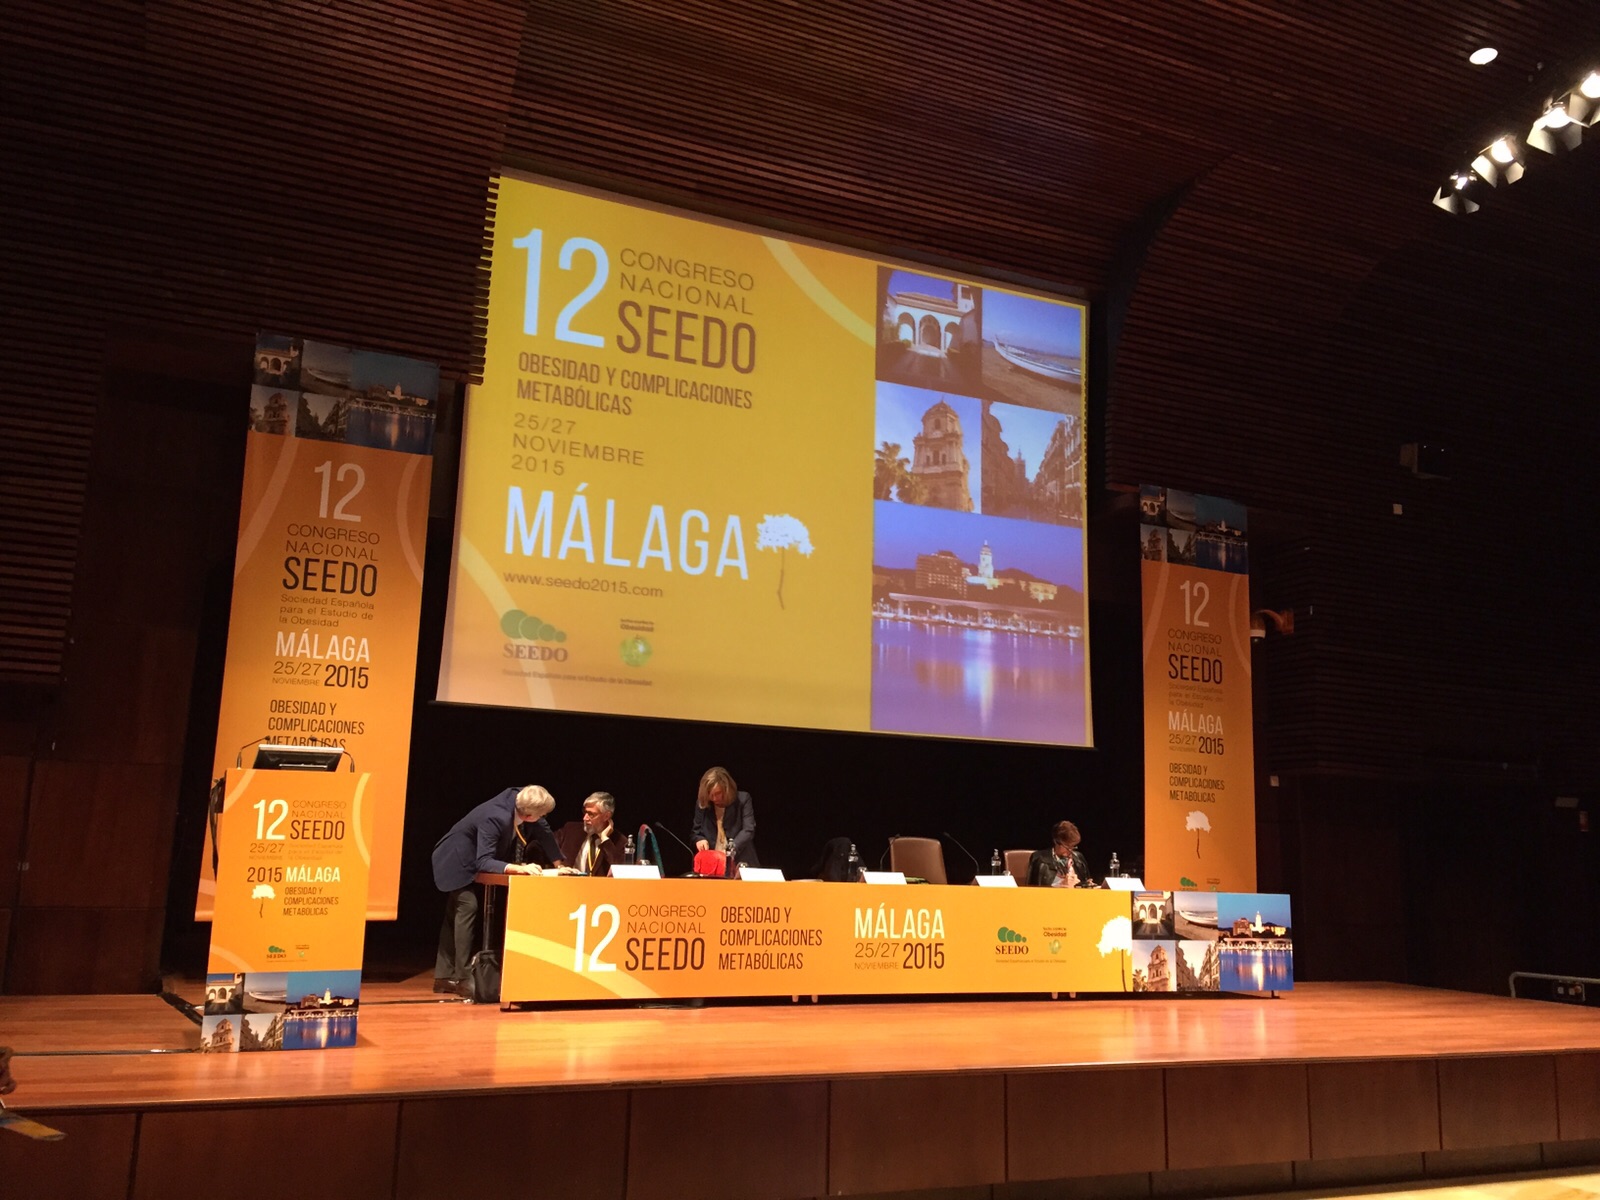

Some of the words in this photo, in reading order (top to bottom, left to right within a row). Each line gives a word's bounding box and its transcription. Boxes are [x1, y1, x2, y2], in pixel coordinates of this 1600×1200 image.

[619, 248, 754, 291] CONGRESO
[512, 227, 609, 348] 12
[619, 272, 754, 315] NACIONAL
[616, 300, 756, 374] SEEDO
[518, 351, 600, 384] OBESIDAD
[605, 367, 616, 386] Y
[620, 369, 753, 409] COMPLICACIONES
[516, 378, 632, 416] METABÓLICAS
[513, 412, 577, 435] 25/27
[512, 433, 645, 467] NOVIEMBRE
[510, 454, 566, 477] 2015
[313, 460, 366, 523] 12
[287, 523, 380, 545] CONGRESO
[504, 482, 749, 580] MÁLAGA
[285, 540, 379, 562] NACIONAL
[282, 556, 378, 597] SEEDO
[503, 572, 664, 598] www.seedo2015.com
[280, 593, 328, 606] Sociedad
[330, 597, 375, 610] Española
[1179, 579, 1210, 627] 12
[279, 606, 303, 615] para
[307, 606, 316, 615] el
[320, 607, 358, 619] Estudio
[361, 612, 374, 621] de
[279, 615, 288, 624] la
[290, 615, 339, 628] Obesidad
[275, 628, 370, 663] MÁLAGA
[1168, 628, 1222, 645] CONGRESO
[502, 643, 568, 663] SEEDO
[1168, 641, 1222, 657] NACIONAL
[273, 661, 322, 677] 25/27
[324, 664, 369, 689] 2015
[1168, 653, 1223, 685] SEEDO
[272, 677, 321, 687] NOVIEMBRE
[269, 699, 326, 716] OBESIDAD
[329, 702, 337, 716] Y
[268, 716, 365, 735] COMPLICACIONES
[1168, 708, 1224, 735] MÁLAGA
[1168, 733, 1197, 746] 25/27
[1198, 735, 1225, 756] 2015
[1169, 762, 1202, 776] OBESIDAD
[1203, 765, 1208, 776] Y
[1169, 775, 1225, 791] COMPLICACIONES
[292, 800, 347, 810] CONGRESO
[1169, 789, 1216, 803] METABÓLICAS
[253, 799, 289, 840] 12
[291, 810, 346, 819] NACIONAL
[290, 819, 345, 841] SEEDO
[249, 842, 285, 854] 25/27
[247, 866, 282, 883] 2015
[285, 863, 341, 883] MÁLAGA
[283, 896, 340, 906] COMPLICACIONES
[284, 886, 317, 896] OBESIDAD
[318, 886, 324, 896] Y
[627, 904, 707, 918] CONGRESO
[720, 906, 781, 924] OBESIDAD
[784, 907, 792, 923] Y
[854, 902, 945, 940] MÁLAGA
[568, 903, 621, 973] 12
[626, 921, 706, 935] NACIONAL
[719, 928, 823, 947] COMPLICACIONES
[625, 937, 706, 972] SEEDO
[718, 950, 804, 971] METABÓLICAS
[854, 942, 900, 958] 25/27
[903, 942, 945, 970] 2015
[995, 945, 1029, 955] SEEDO
[854, 961, 899, 970] NOVIEMBRE
